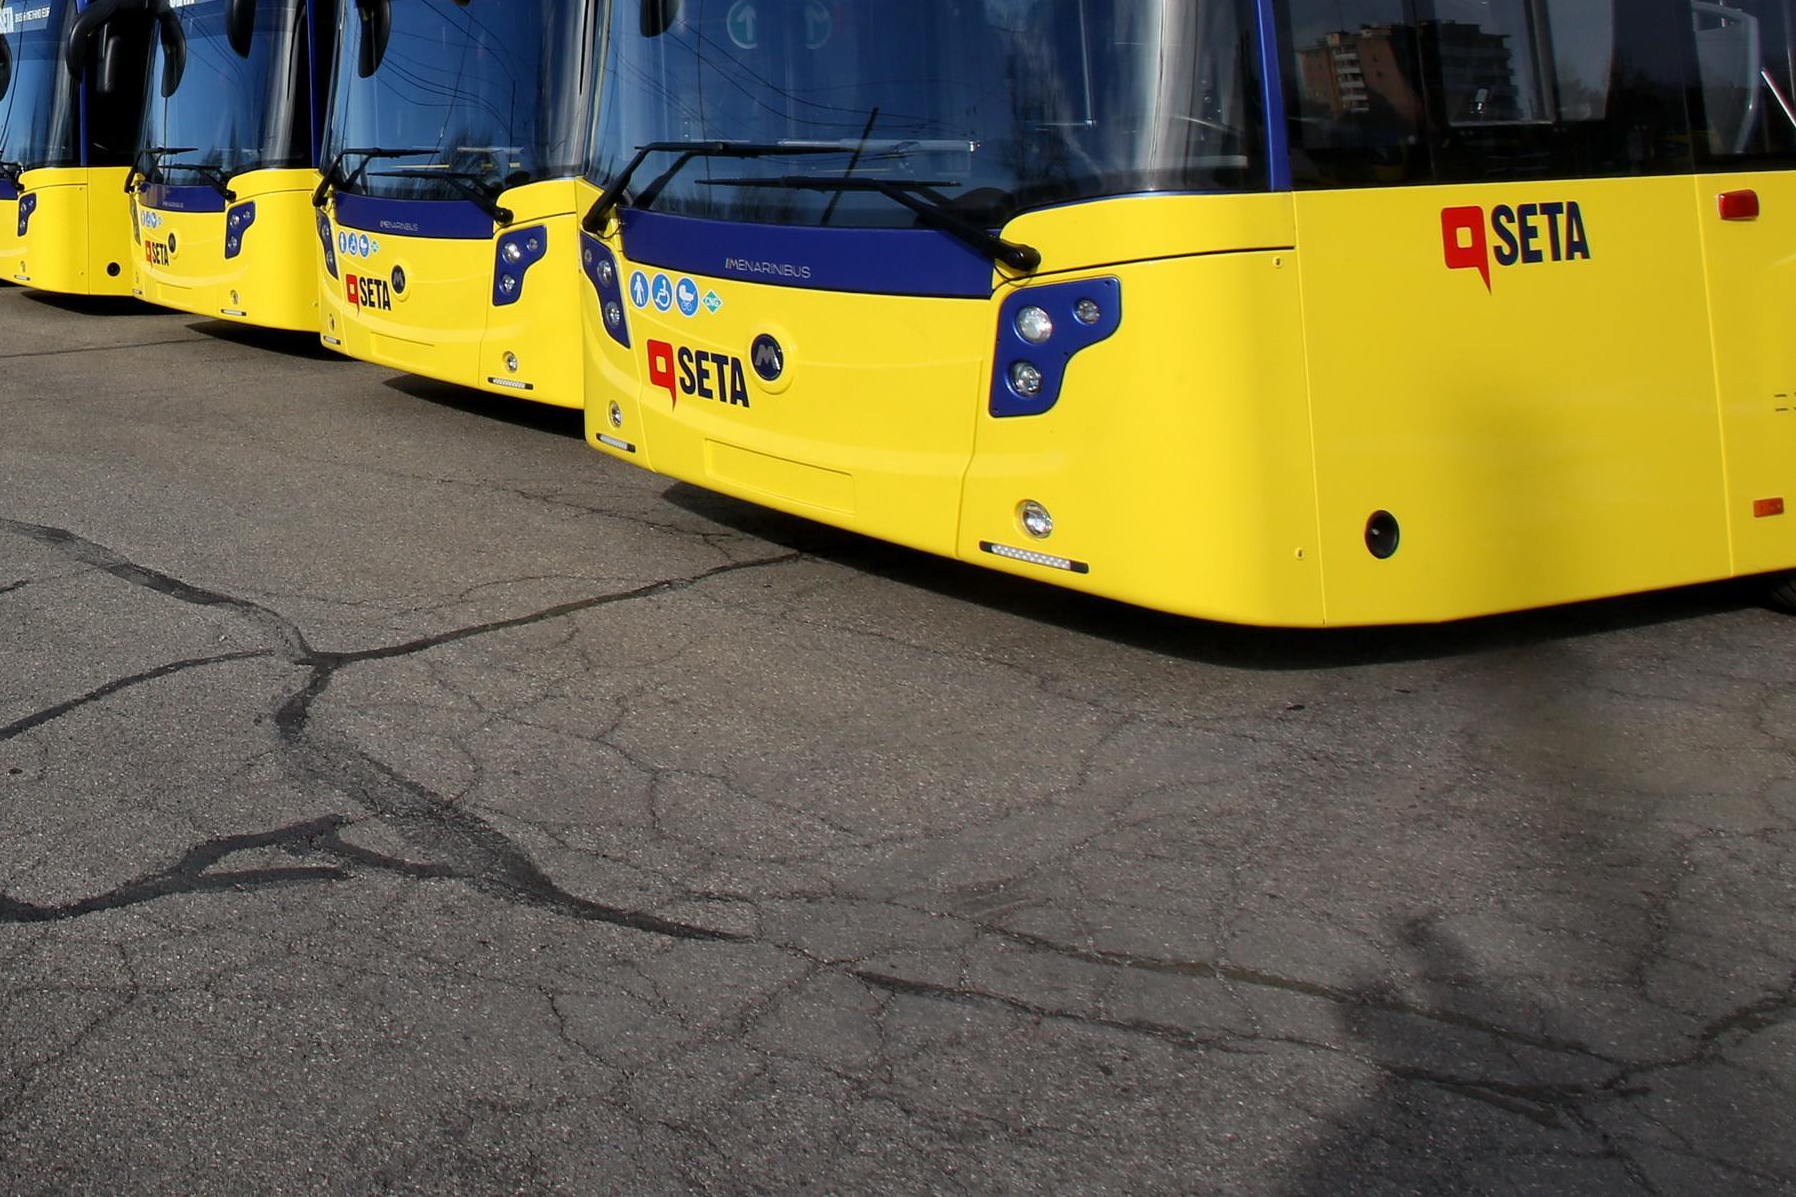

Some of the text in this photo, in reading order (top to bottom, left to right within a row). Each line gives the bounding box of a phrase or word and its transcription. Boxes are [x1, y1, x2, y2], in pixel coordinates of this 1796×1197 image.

[1490, 201, 1590, 266] SETA
[152, 242, 169, 266] SETA
[359, 276, 391, 311] SETA
[705, 297, 719, 307] CNG
[678, 346, 750, 408] SETA
